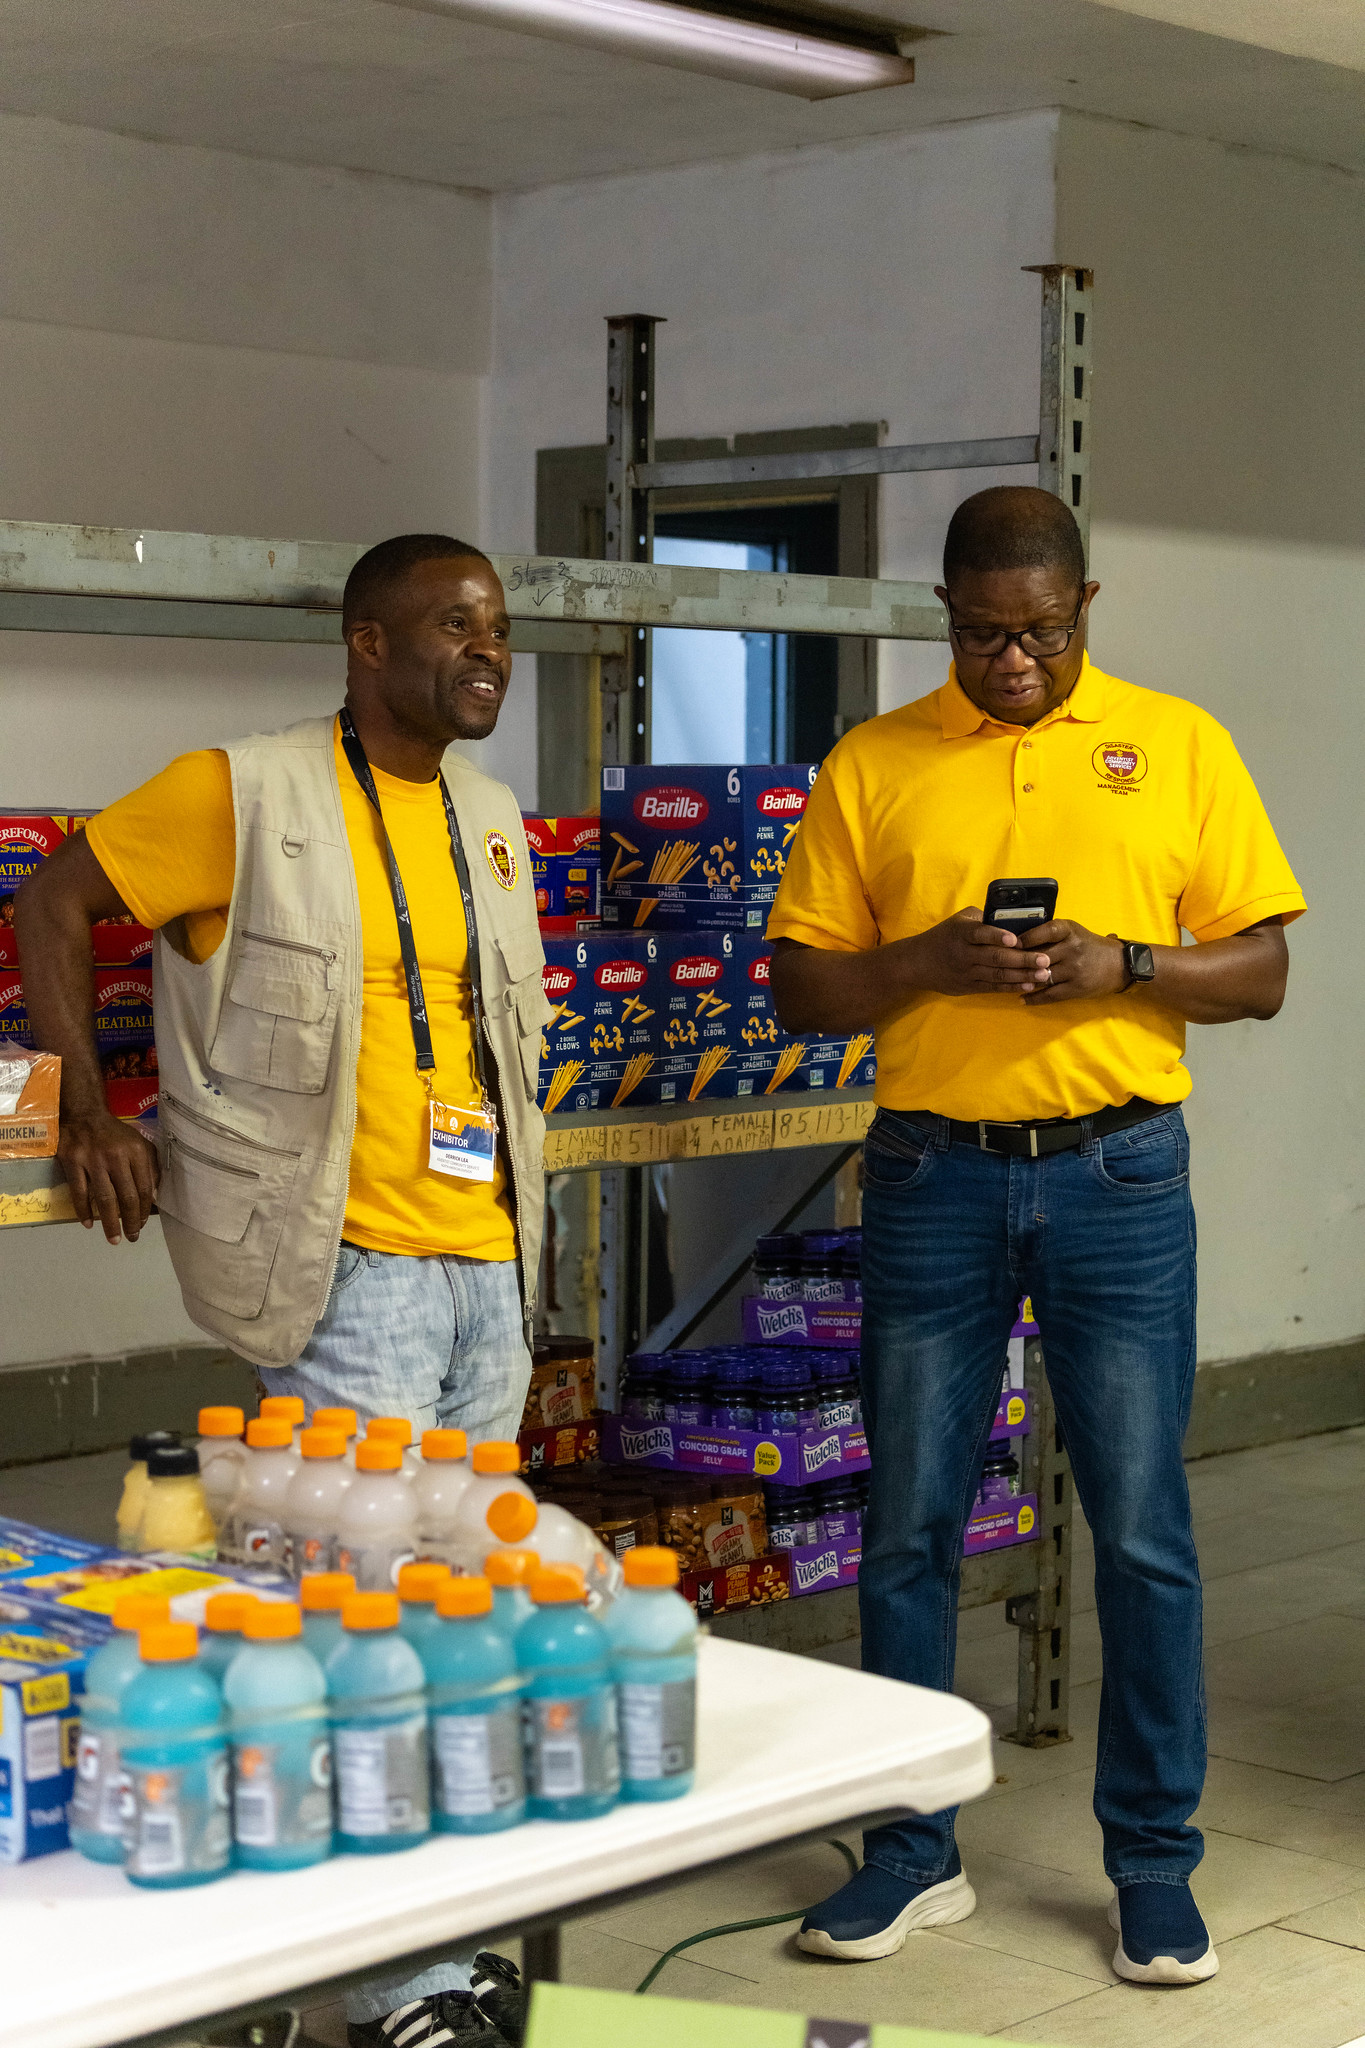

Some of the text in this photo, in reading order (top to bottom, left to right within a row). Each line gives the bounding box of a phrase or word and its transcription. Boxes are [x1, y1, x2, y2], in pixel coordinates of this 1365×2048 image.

[1105, 743, 1134, 751] DISASTER
[727, 768, 741, 797] 6
[808, 767, 818, 786] 6
[1104, 772, 1137, 783] RESPONSE
[1097, 783, 1141, 793] MANAGEMENT
[641, 797, 700, 819] Barilla
[762, 794, 803, 811] Barilla
[756, 832, 774, 840] PENNE
[489, 857, 508, 887] DISASTER
[657, 890, 687, 899] SPAGHETTI
[709, 893, 732, 901] ELBOWS
[647, 938, 657, 958] 6
[723, 934, 733, 954] 6
[577, 942, 587, 963] 6
[601, 967, 642, 985] Barilla
[676, 962, 718, 980] Barilla
[413, 961, 424, 1006] Adventist Church
[541, 972, 570, 990] arilla
[410, 974, 419, 1007] Seventh-day
[669, 1002, 687, 1011] PENNE
[747, 1001, 766, 1009] PENNE
[594, 1008, 613, 1017] PENNE
[629, 1035, 651, 1043] ELBOWS
[703, 1028, 727, 1037] ELBOWS
[556, 1042, 580, 1051] ELBOWS
[813, 1050, 840, 1061] SPAGHETTI
[664, 1063, 693, 1073] SPAGHETTI
[742, 1060, 772, 1070] SPAGHETTI
[591, 1070, 618, 1080] PAGHETTI
[0, 1126, 35, 1140] HICKEN
[433, 1130, 469, 1149] EXHIBITOR
[806, 1283, 842, 1301] Welch's
[759, 1307, 805, 1336] Welch's
[812, 1317, 849, 1327] CONCORD
[835, 1328, 854, 1338] JELLY
[622, 1429, 673, 1459] Welch's
[679, 1440, 748, 1458] CONCORD GRAPE
[703, 1455, 723, 1466] JELLY
[757, 1451, 776, 1460] Value
[806, 1438, 839, 1471] Welch's
[758, 1458, 776, 1468] Pack
[967, 1521, 996, 1535] CONCORD
[995, 1516, 1015, 1529] GRAPE
[984, 1529, 999, 1540] JELLY
[764, 1564, 774, 1587] 2
[797, 1553, 837, 1590] Welch's
[727, 1578, 749, 1590] PEANUT
[727, 1586, 749, 1599] BUTTER
